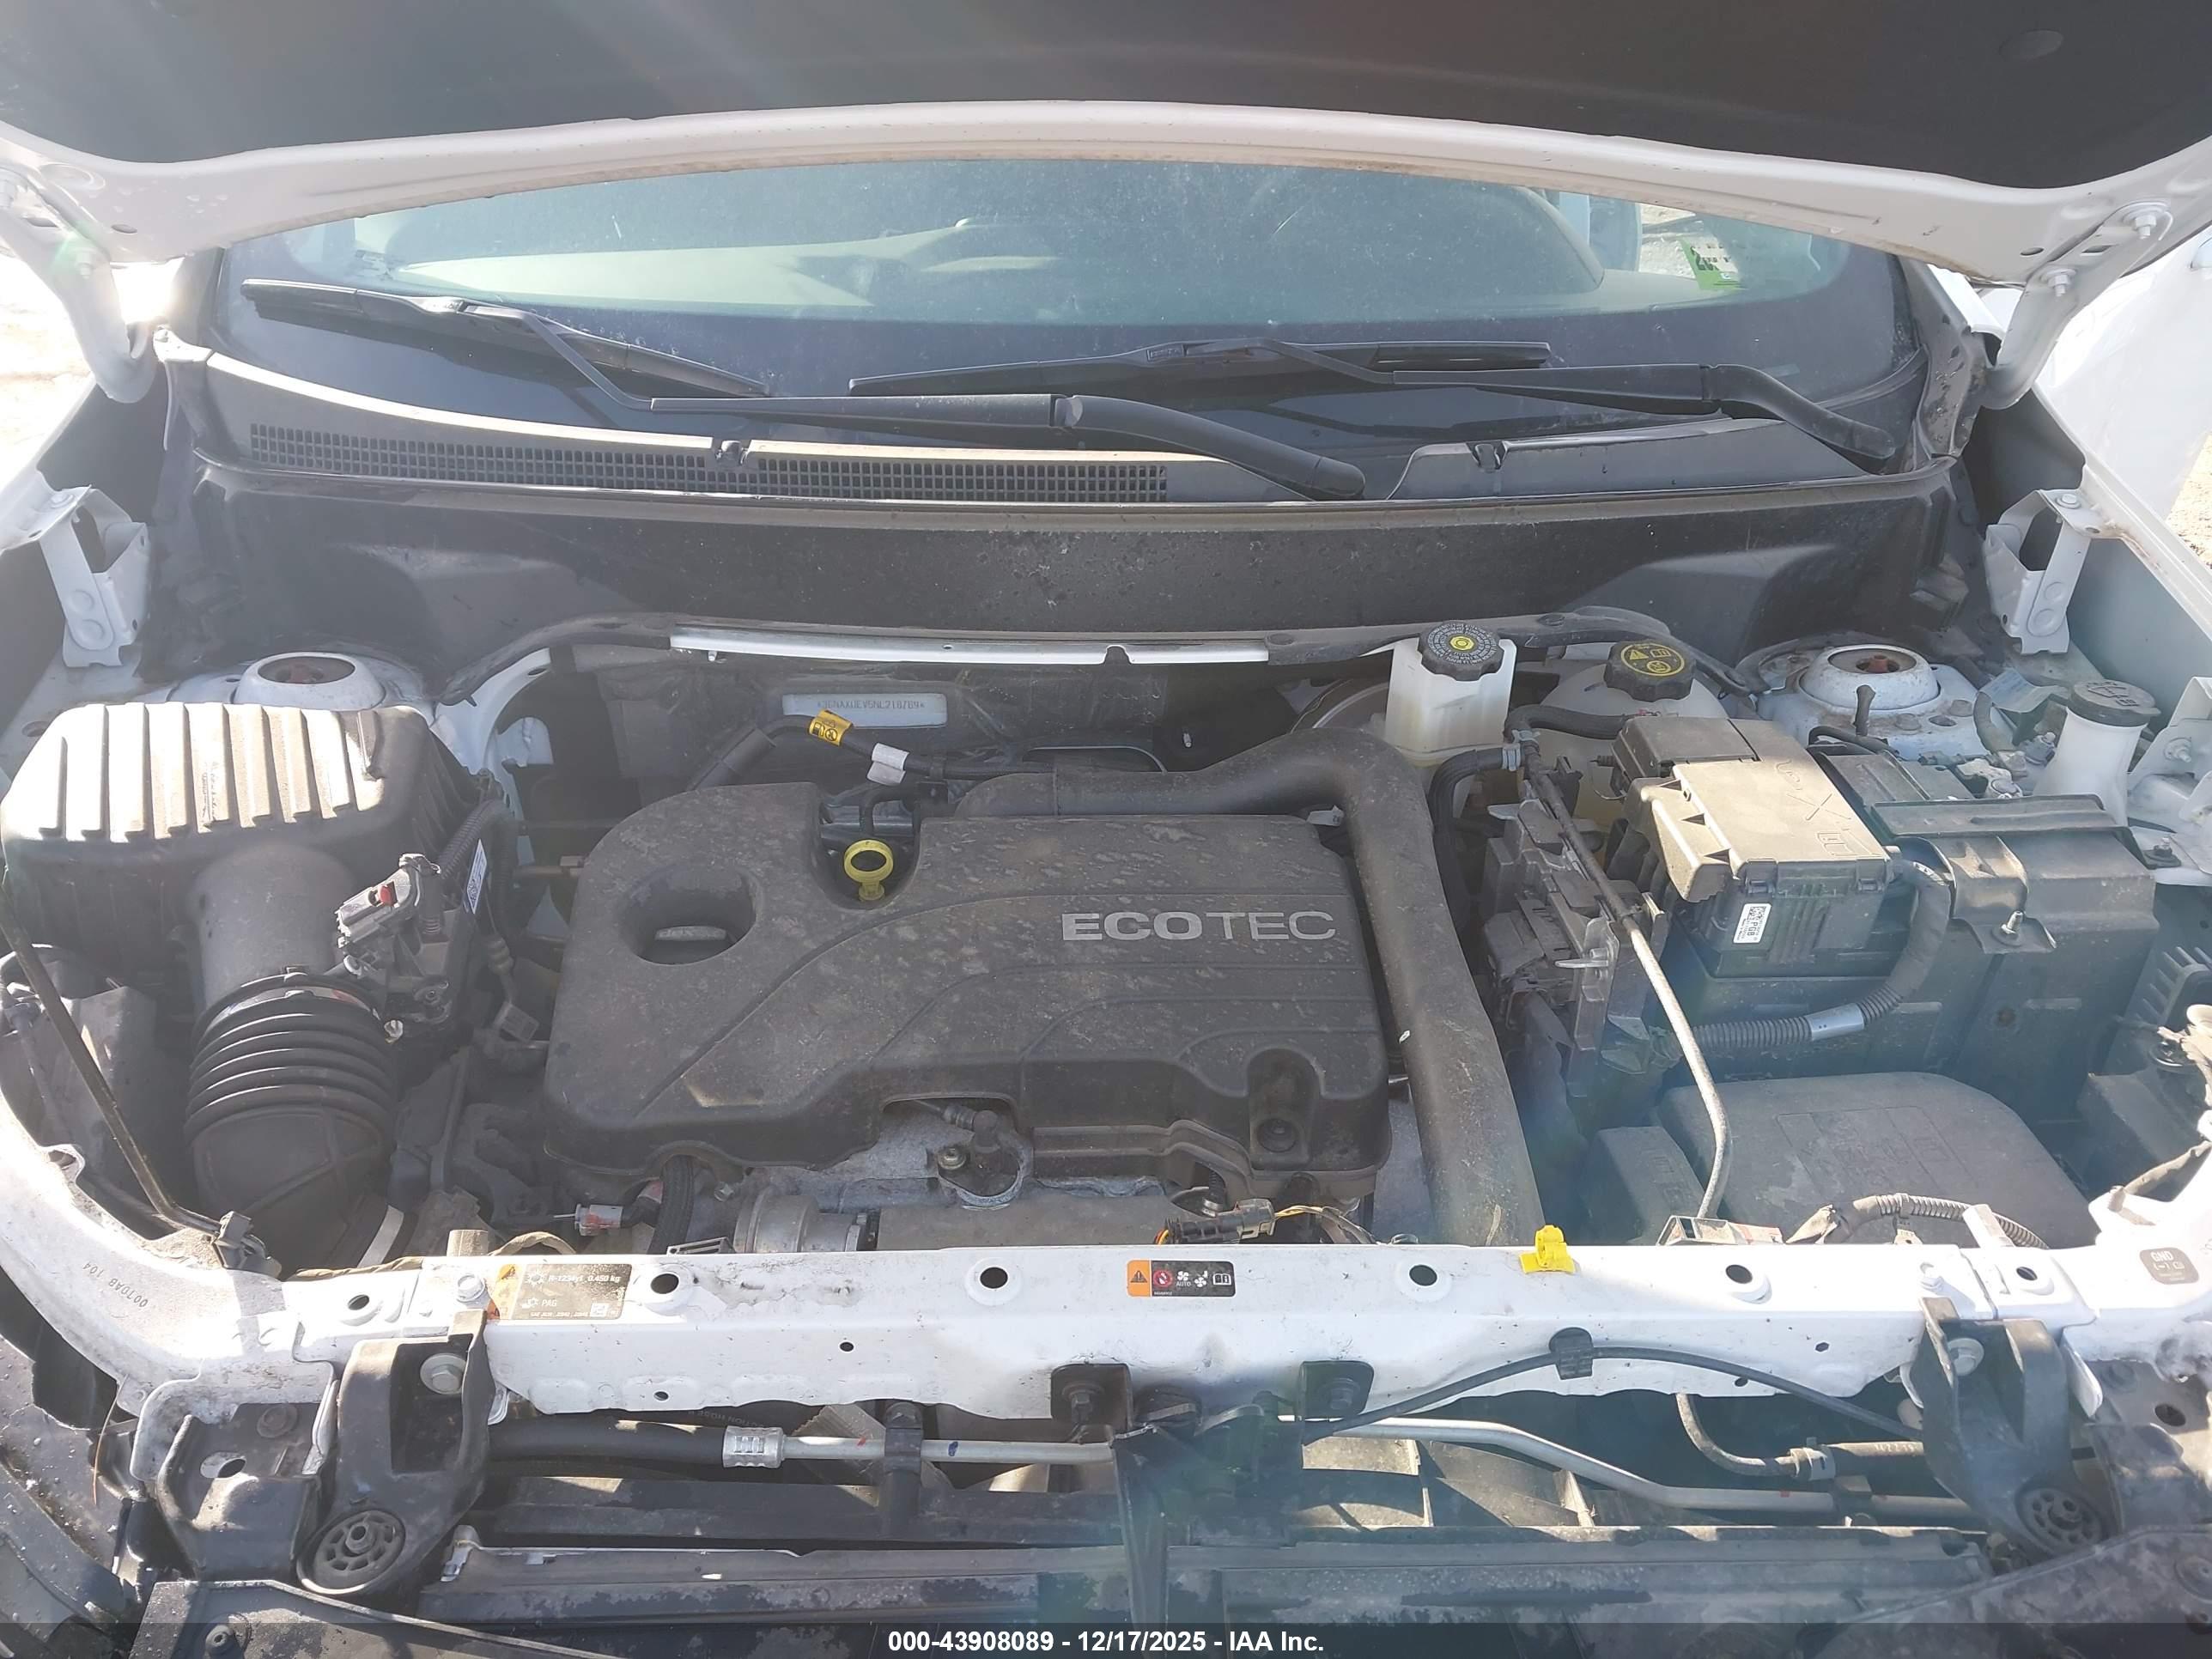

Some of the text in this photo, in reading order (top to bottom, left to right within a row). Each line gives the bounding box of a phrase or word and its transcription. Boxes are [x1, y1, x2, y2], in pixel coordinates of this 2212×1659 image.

[1061, 911, 1336, 941] ECOTEC
[1747, 921, 1758, 936] PGB
[2150, 1250, 2174, 1262] GND
[82, 1261, 104, 1278] 104
[610, 1274, 622, 1284] kg
[541, 1298, 557, 1307] PAG
